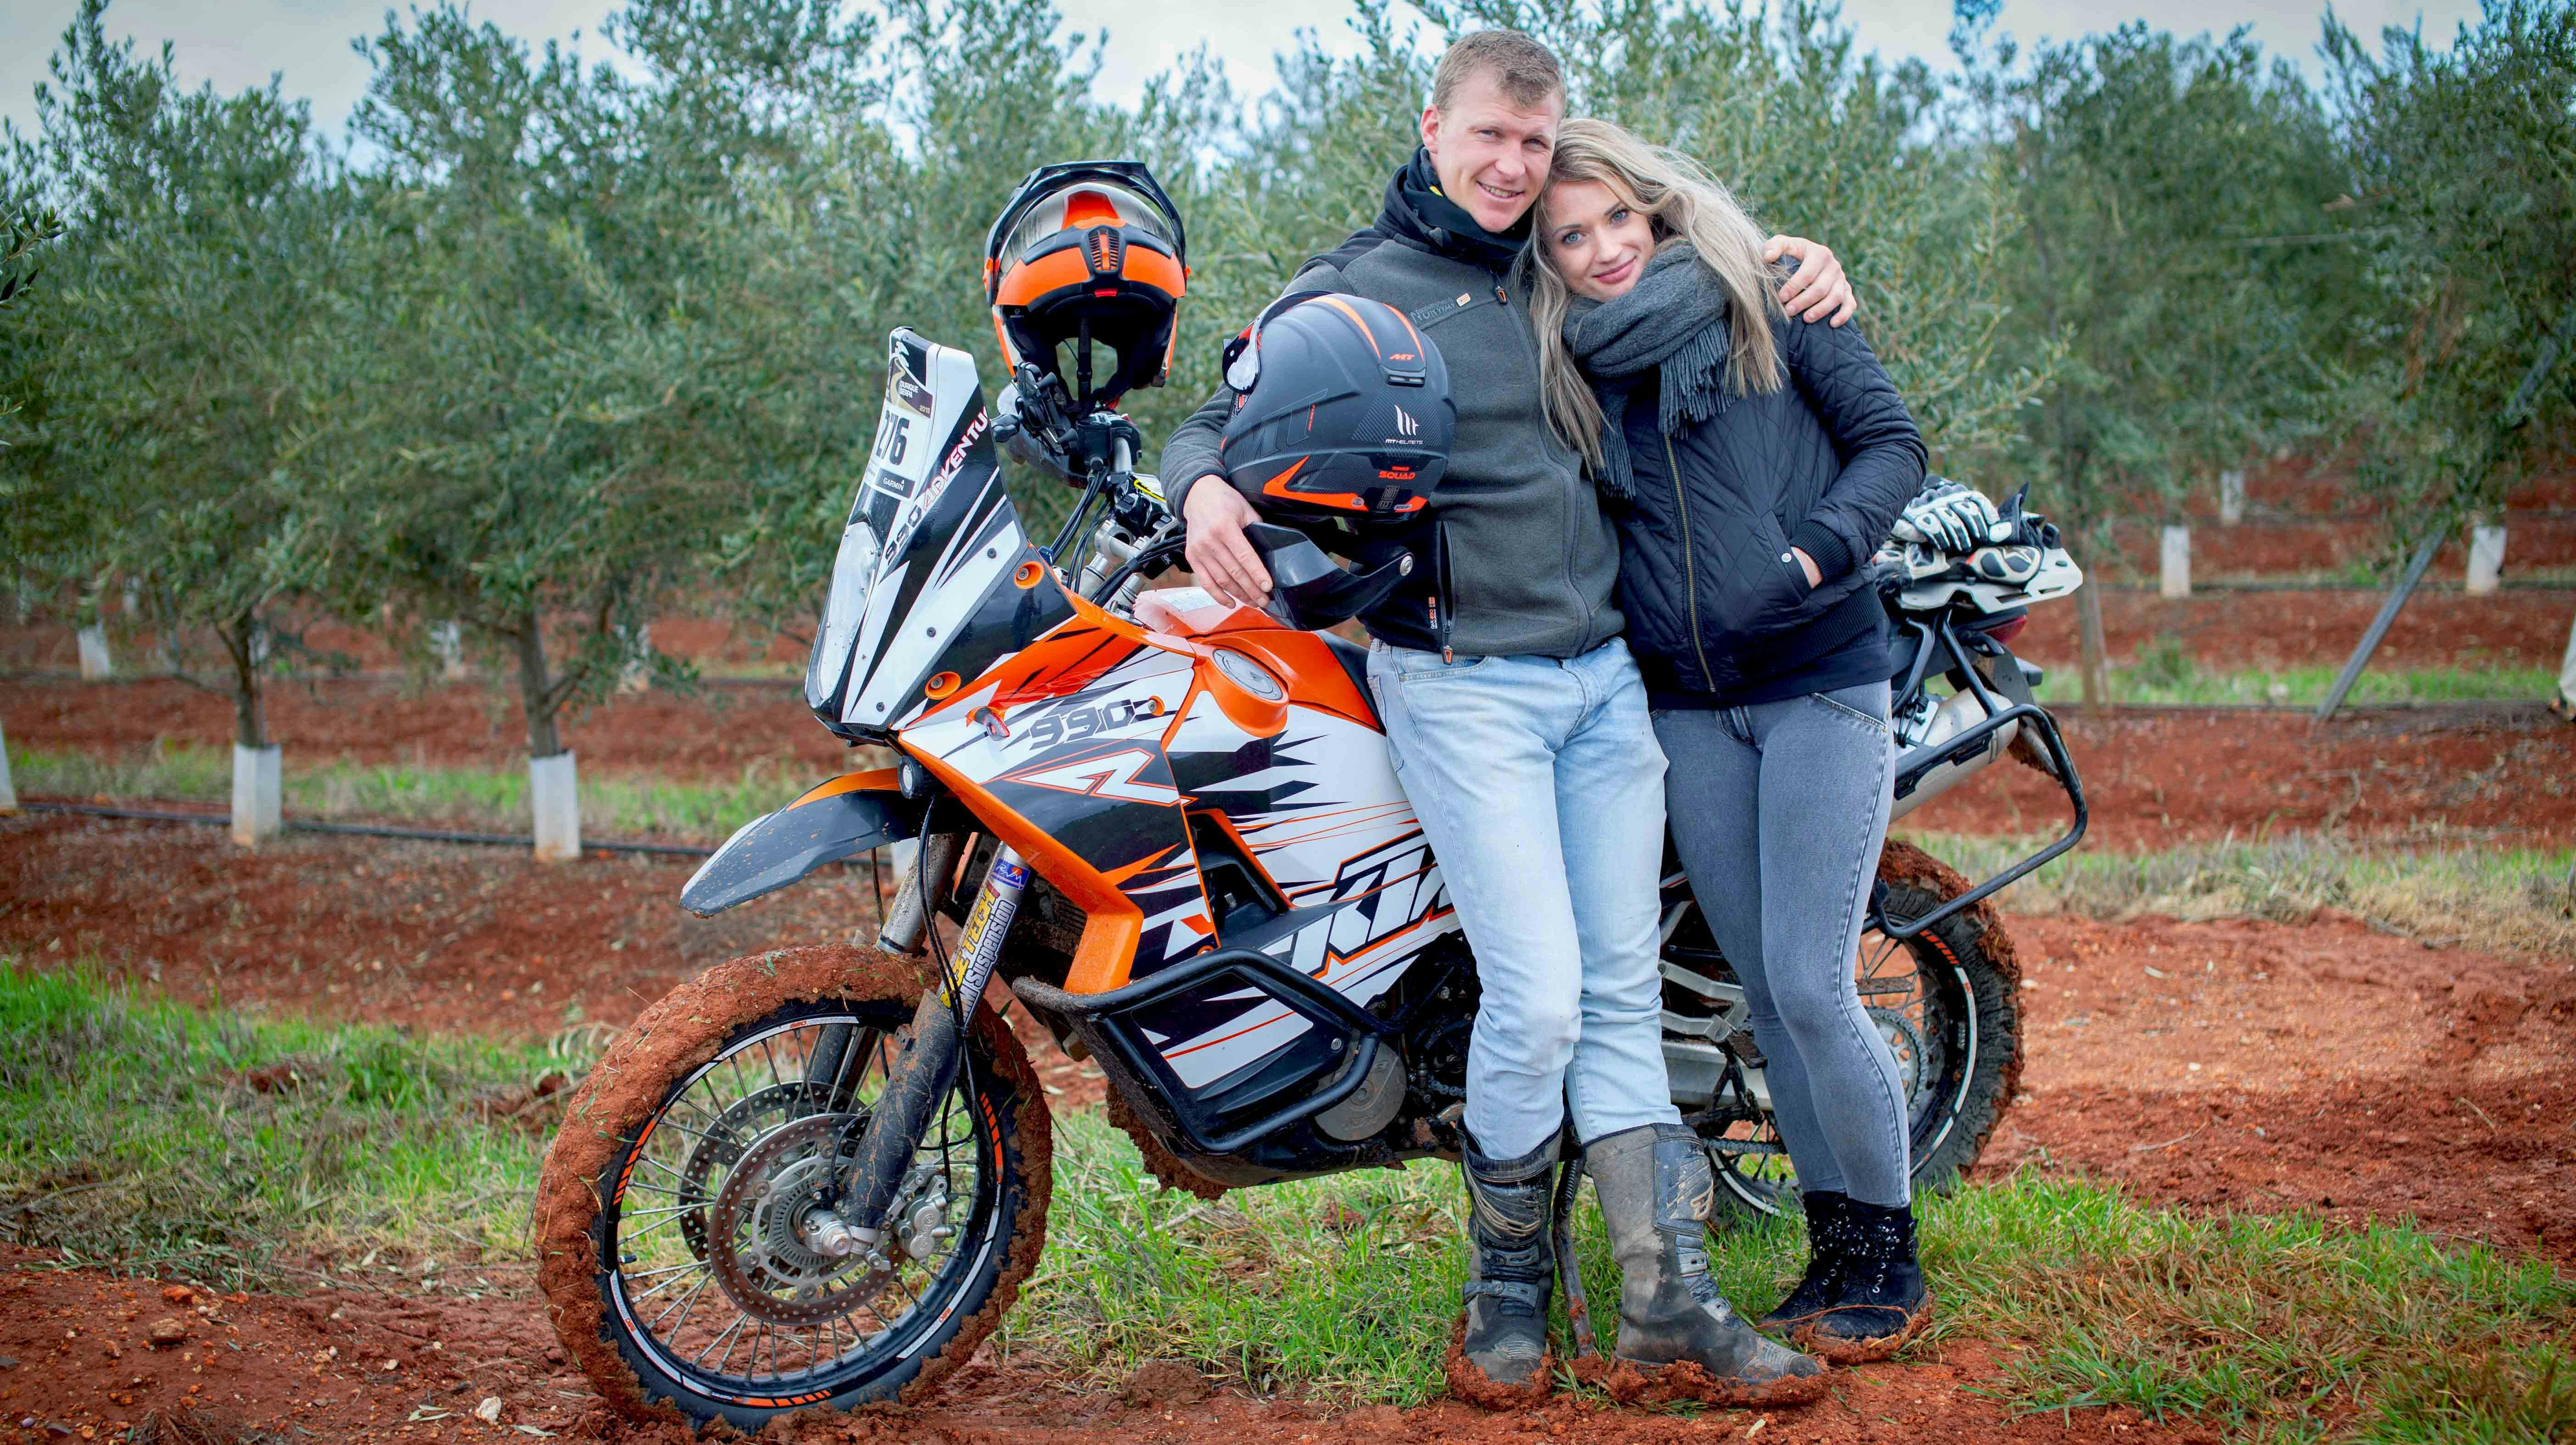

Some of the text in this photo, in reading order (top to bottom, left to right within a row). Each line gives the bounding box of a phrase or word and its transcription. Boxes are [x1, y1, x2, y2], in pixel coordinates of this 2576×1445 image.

[883, 478, 904, 491] GARMIN
[1379, 470, 1416, 480] SQUAD
[1029, 699, 1136, 751] 990
[965, 900, 1016, 988] Suspension
